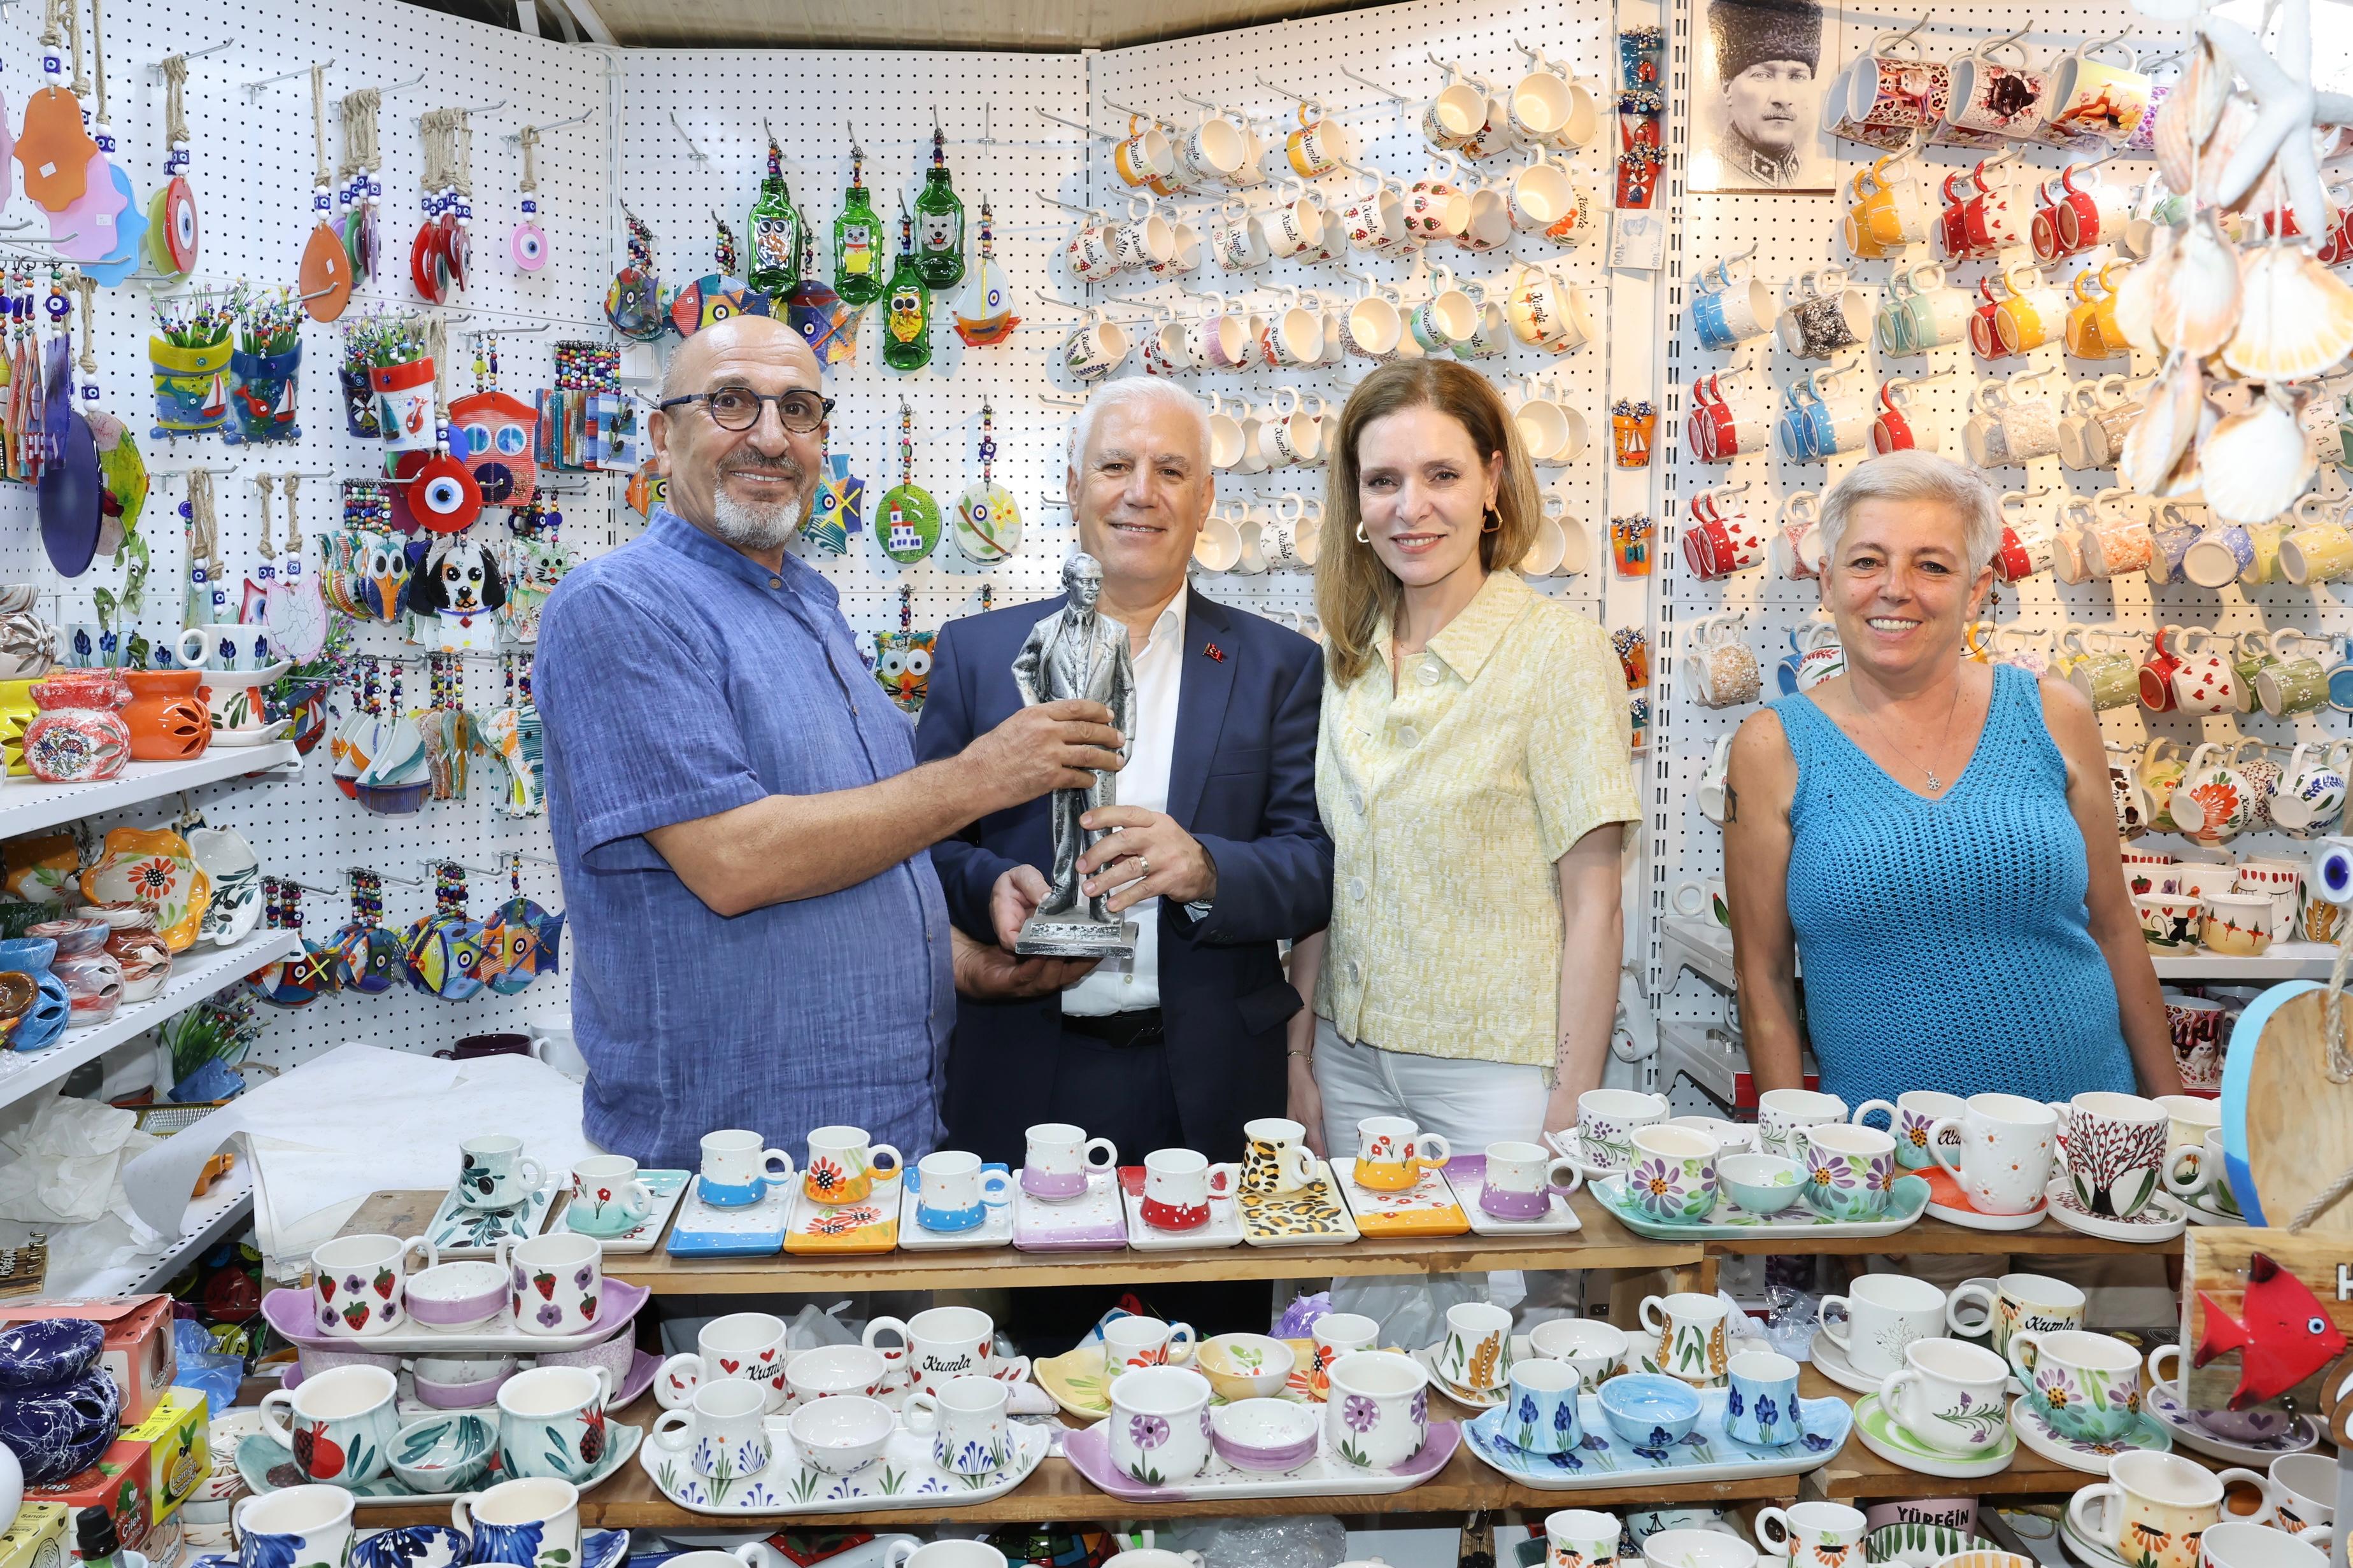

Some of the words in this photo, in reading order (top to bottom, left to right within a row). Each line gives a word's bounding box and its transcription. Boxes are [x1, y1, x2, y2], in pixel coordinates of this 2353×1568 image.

[1431, 106, 1442, 132] Kumla
[1131, 141, 1144, 170] Kumla
[1191, 133, 1200, 160] Kumla
[1304, 134, 1320, 165] Kumla
[1362, 204, 1377, 234] Kumla
[1576, 194, 1590, 229] Kumla
[1282, 213, 1298, 243] Kumla
[1083, 239, 1098, 265] Kumla
[1131, 232, 1145, 260] Kumla
[1230, 229, 1246, 257] Kumla
[1531, 292, 1548, 325] Kumla
[1423, 309, 1439, 340] Kumla
[1081, 333, 1094, 360] Kumla
[1150, 338, 1162, 365] Kumla
[1271, 327, 1285, 357] Kumla
[1274, 427, 1290, 457] Kumla
[1278, 530, 1290, 560] Kumla
[2025, 1315, 2075, 1332] Kumla
[744, 1353, 786, 1381] Kumla
[922, 1353, 972, 1372] Kumla
[41, 1483, 71, 1492] Yağı
[172, 1460, 197, 1488] Lemon
[173, 1471, 197, 1495] AromaOil
[122, 1511, 141, 1539] Çilek
[1897, 1506, 1970, 1527] YÜREĞİN
[160, 1542, 180, 1567] Powder
